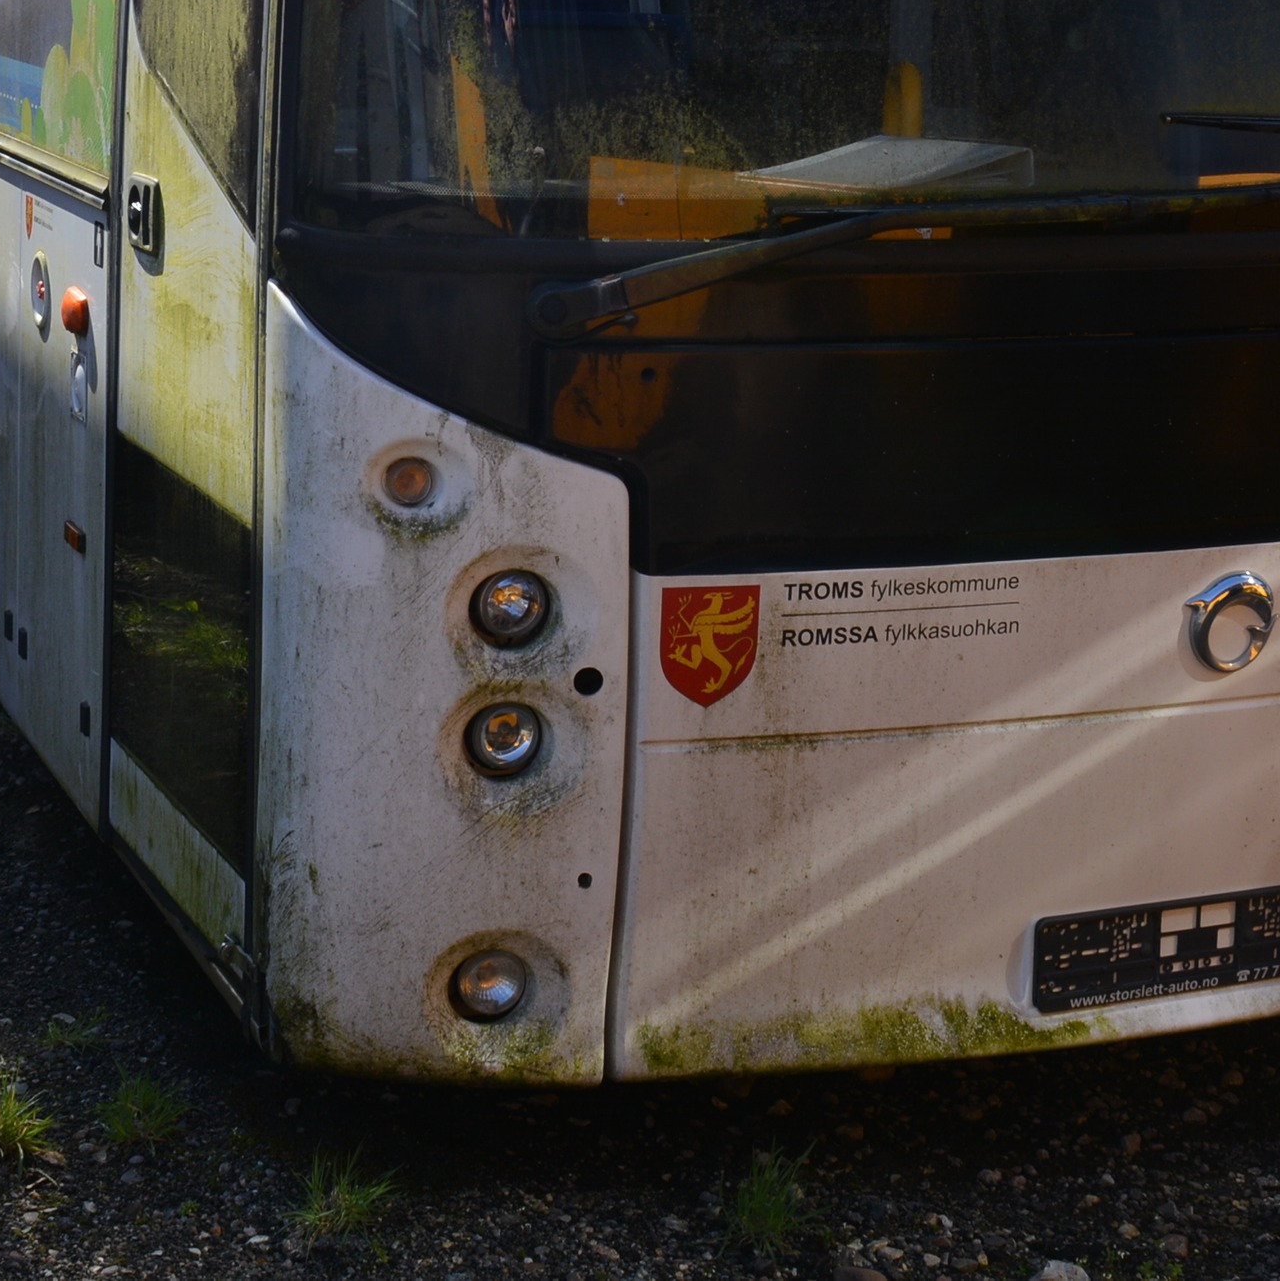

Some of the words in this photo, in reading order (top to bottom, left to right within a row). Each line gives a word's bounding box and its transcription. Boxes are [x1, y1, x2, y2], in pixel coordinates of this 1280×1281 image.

[784, 581, 864, 601] TROMS
[871, 576, 1020, 602] fylkeskommune
[781, 626, 879, 647] ROMSSA
[885, 619, 1020, 647] fylkkasuohkan
[1070, 976, 1219, 1009] www.storslett-auto.no
[1253, 967, 1268, 980] 77
